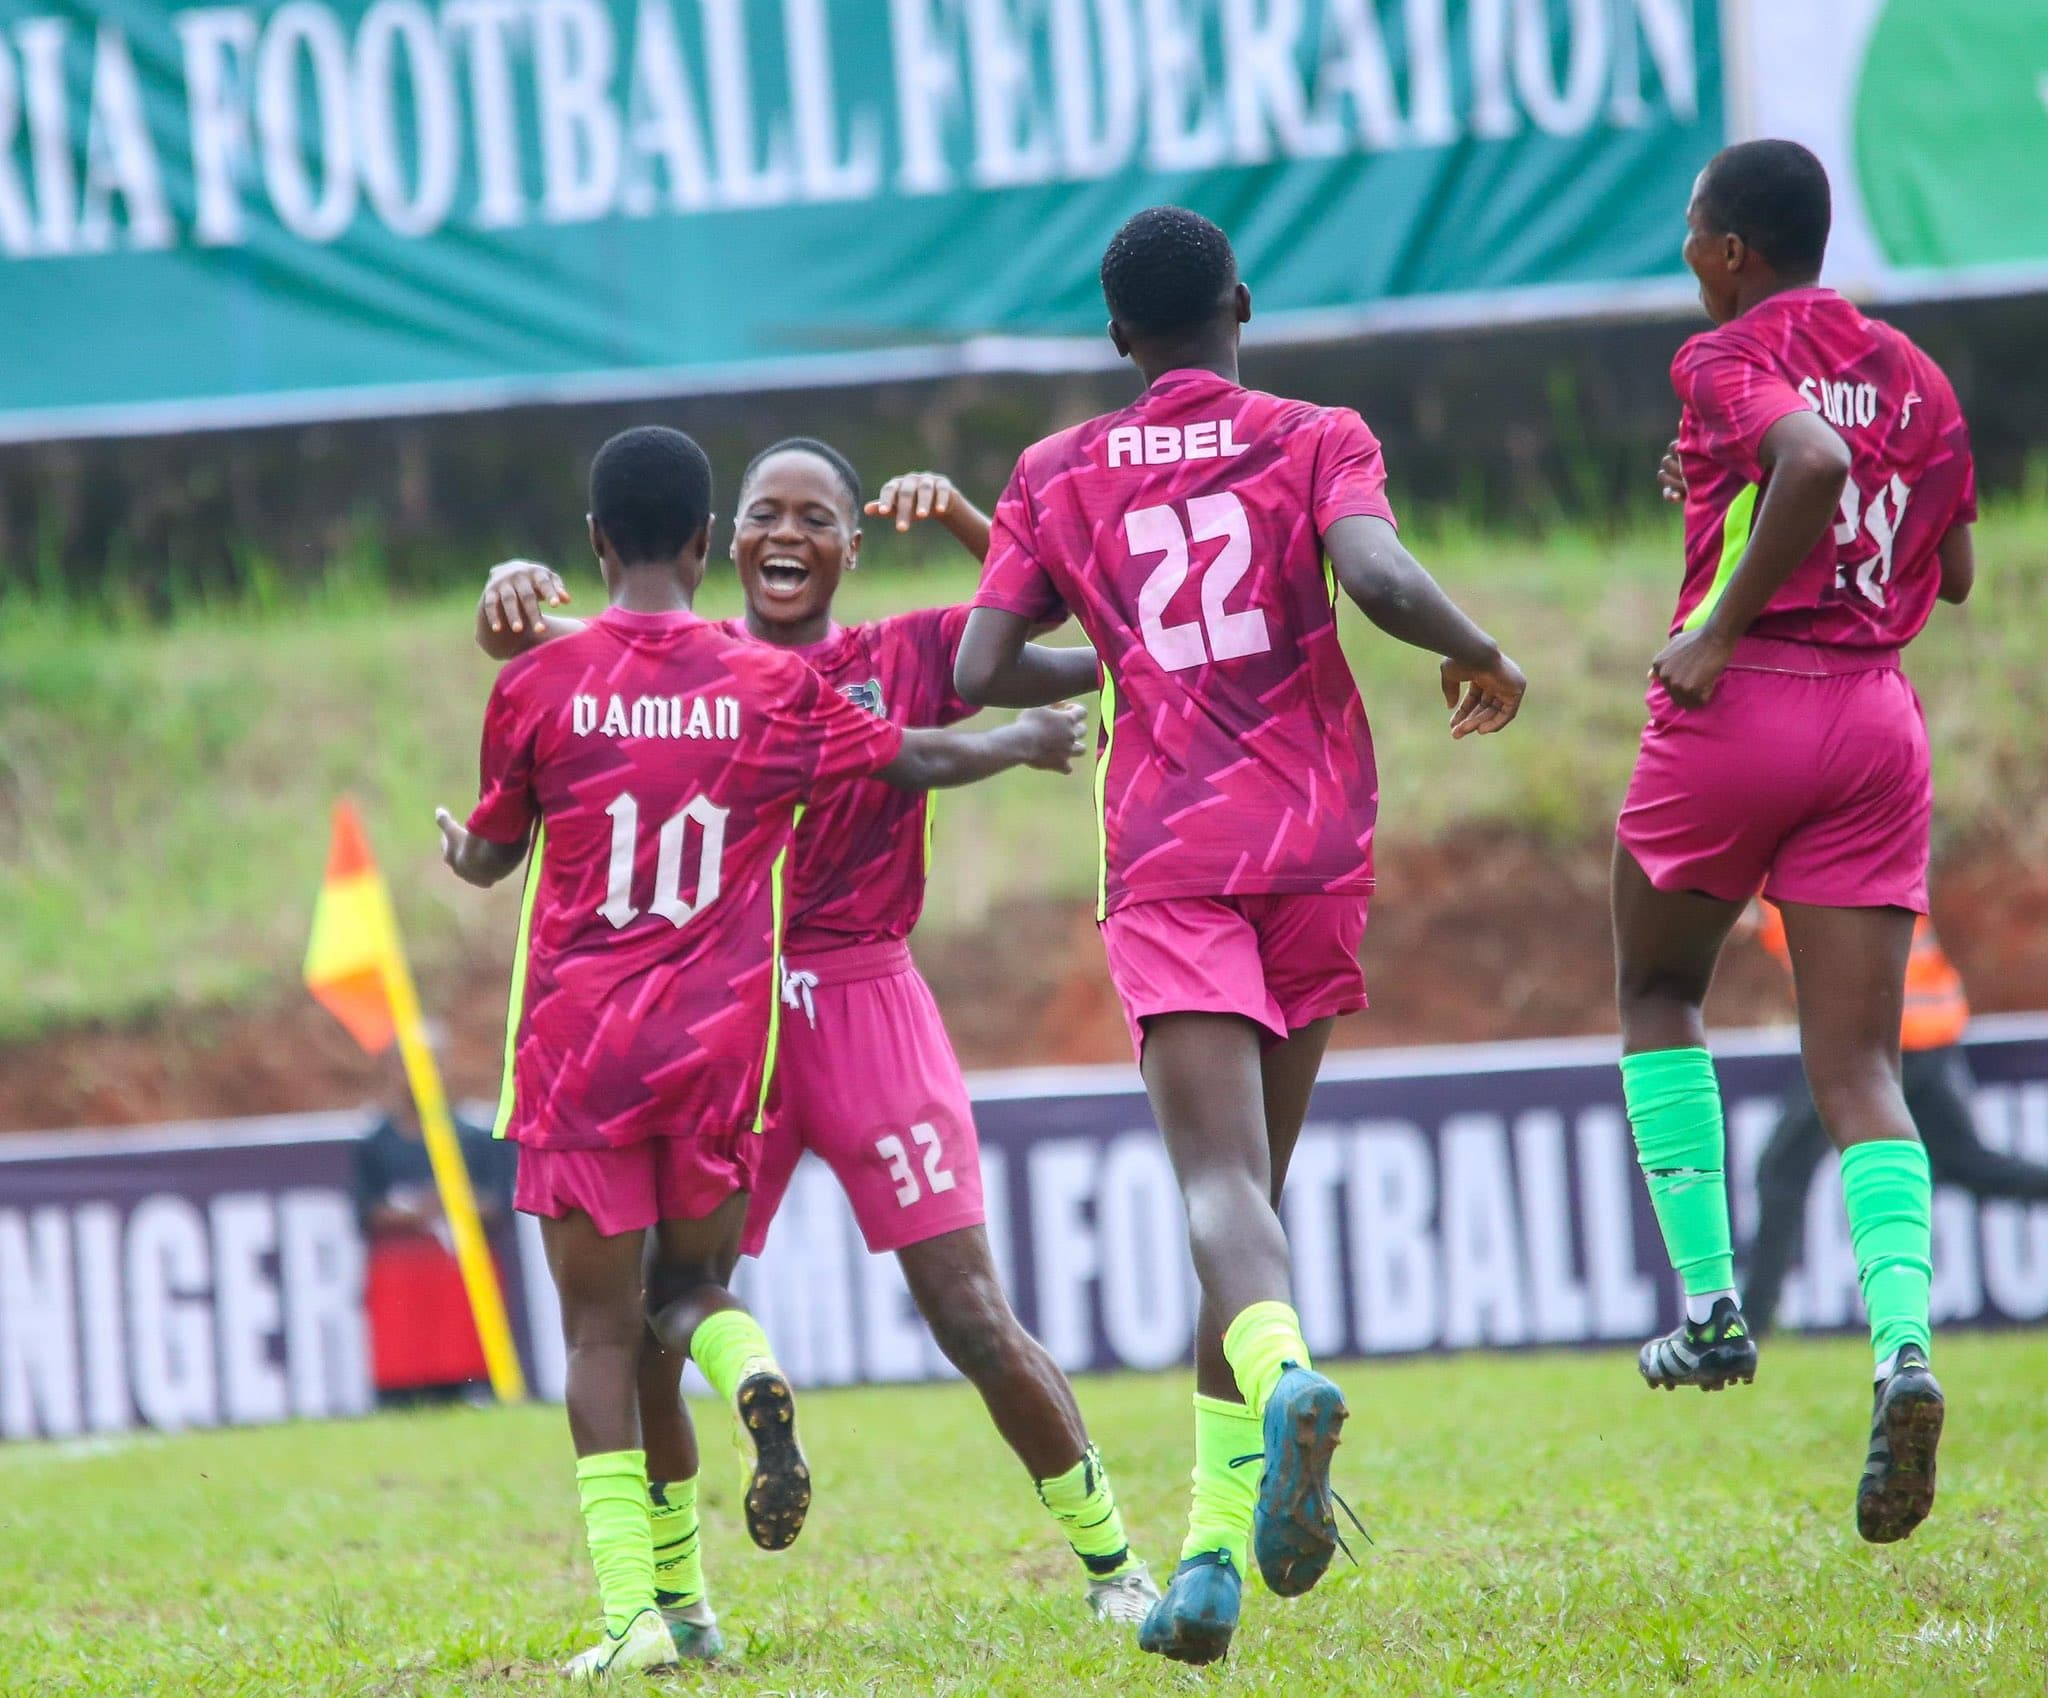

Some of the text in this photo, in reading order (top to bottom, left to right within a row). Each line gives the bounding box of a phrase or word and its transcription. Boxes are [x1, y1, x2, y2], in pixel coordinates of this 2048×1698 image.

[175, 0, 880, 243] FOOTBALL
[890, 0, 1700, 193] FEDERATION
[1107, 419, 1250, 468] ABEL
[1124, 491, 1271, 672] 22
[572, 693, 740, 741] DAMIAN
[596, 791, 731, 930] 10
[874, 1122, 957, 1208] 32
[1028, 1105, 1658, 1372] FOTBALL
